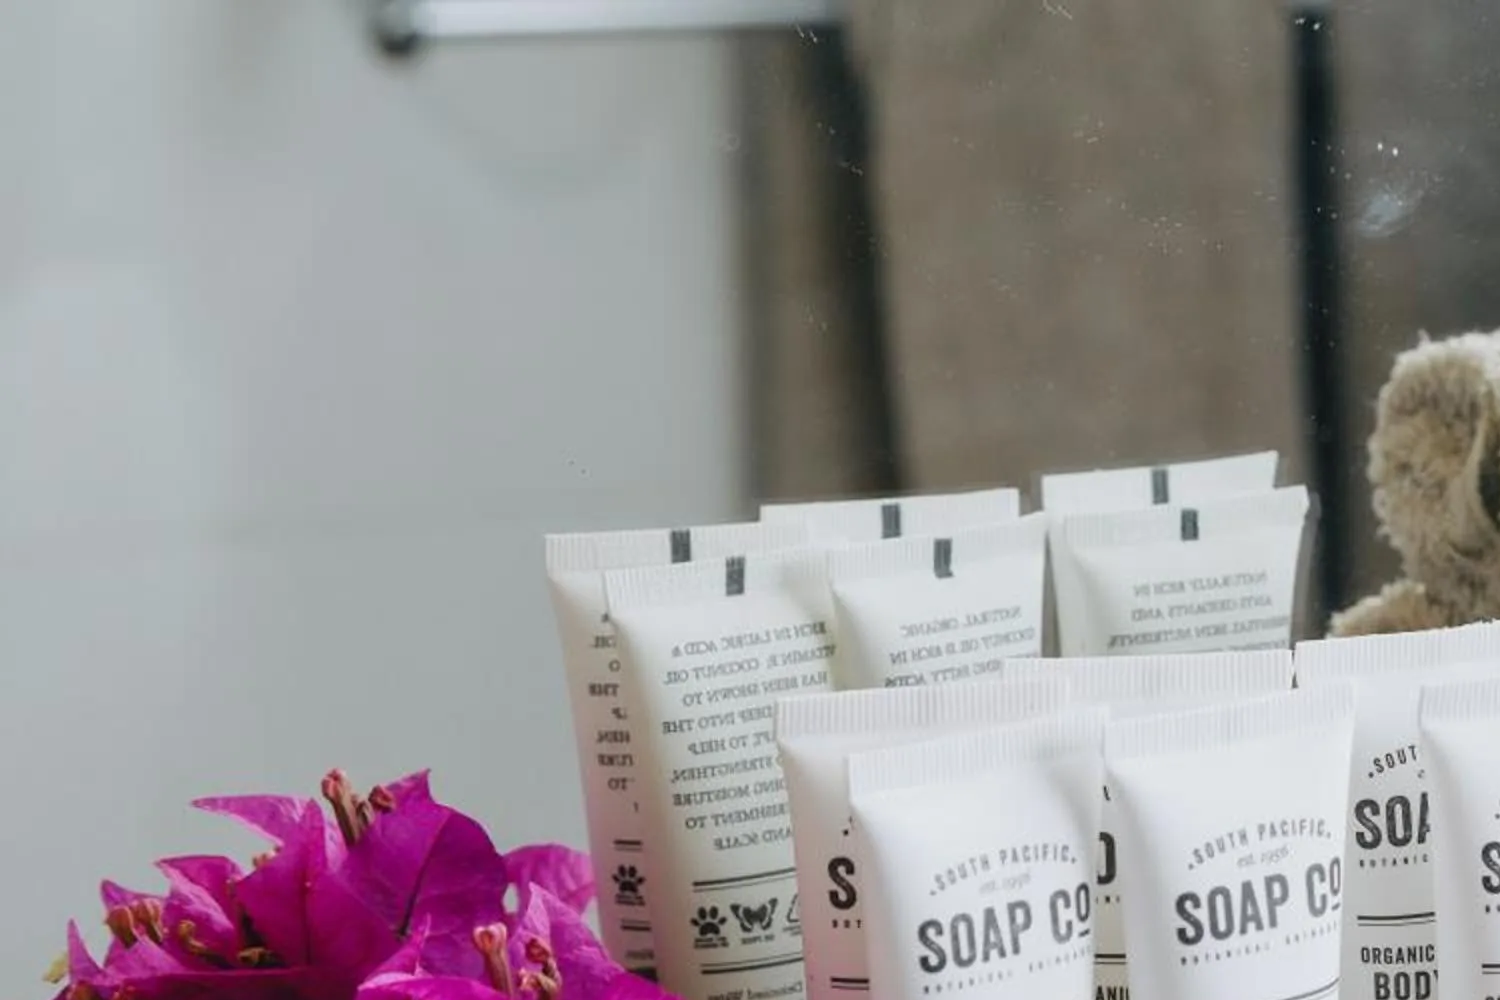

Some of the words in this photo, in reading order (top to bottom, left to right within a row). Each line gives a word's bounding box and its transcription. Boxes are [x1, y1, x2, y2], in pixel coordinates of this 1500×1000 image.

[918, 900, 1032, 973] SOAP
[1175, 873, 1289, 946] SOAP
[1361, 944, 1435, 965] ORGANIC
